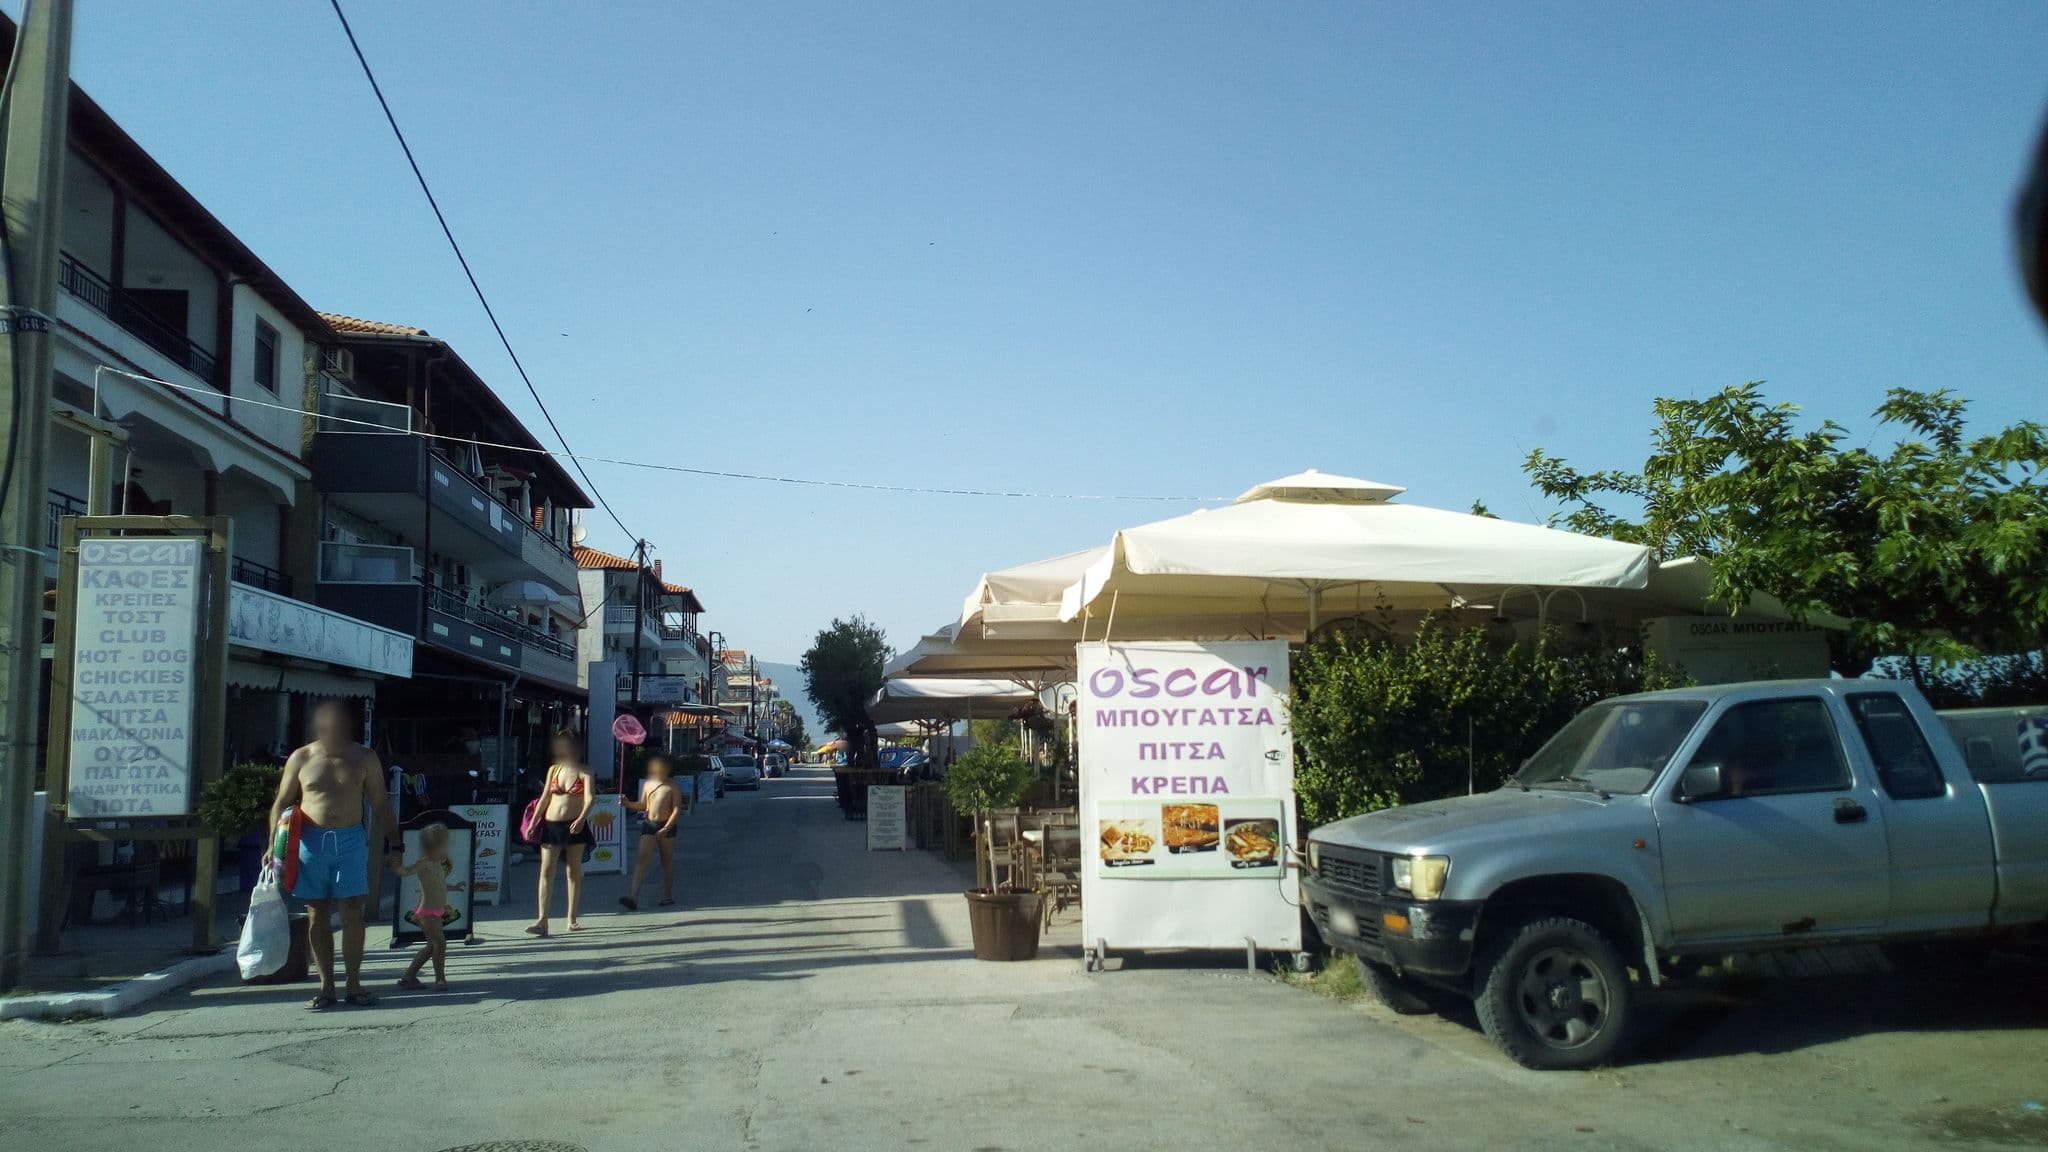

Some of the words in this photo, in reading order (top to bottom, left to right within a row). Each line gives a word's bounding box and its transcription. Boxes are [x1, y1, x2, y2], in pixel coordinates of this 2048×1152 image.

[81, 543, 193, 563] oscar
[82, 570, 189, 589] ΚΑΦΕΣ
[95, 593, 177, 606] ΚΡΕΠΕΣ
[103, 611, 165, 624] ΤΟΣΤ
[99, 630, 167, 643] CLUB
[77, 649, 121, 663] HOT
[142, 649, 188, 663] DOG
[79, 669, 185, 684] CHICKIES
[1089, 667, 1268, 700] oscar
[80, 690, 179, 704] ΣΑΛΑΤΕΣ
[97, 709, 168, 723] ΠΙΤΣΑ
[1096, 708, 1274, 727] ΜΠΟΥΓΑΤΣΑ
[73, 728, 184, 740] ΜΑΚΑΡΟΝΙΑ
[94, 747, 160, 762] ΟΥΖΟ
[1139, 742, 1225, 760] ΠΙΤΣΑ
[84, 765, 170, 779] ΠΑΓΩΤΑ
[71, 783, 182, 795] ΑΝΑΨΥΚΤΙΚΑ
[1131, 776, 1229, 794] ΚΡΕΠΑ
